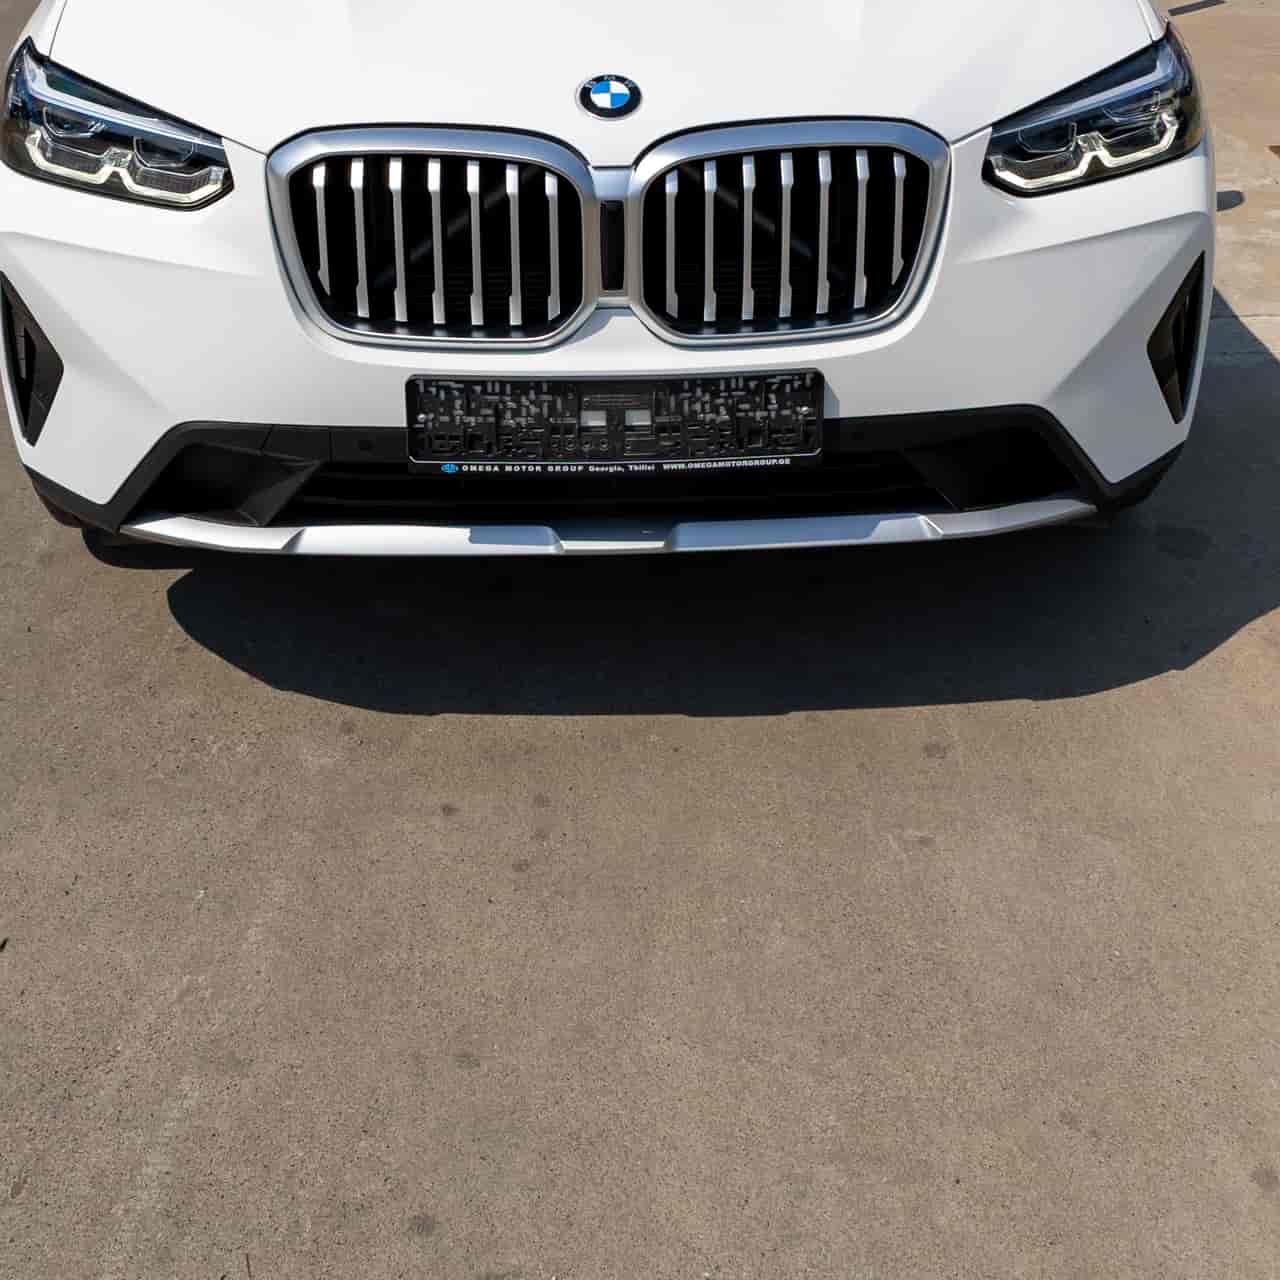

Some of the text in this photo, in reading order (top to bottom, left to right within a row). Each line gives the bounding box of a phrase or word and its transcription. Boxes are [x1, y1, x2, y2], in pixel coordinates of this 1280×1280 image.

[462, 464, 500, 472] OMEGA
[505, 464, 542, 472] MOTOR
[548, 464, 584, 472] GROUP
[628, 463, 656, 471] Tbilisi
